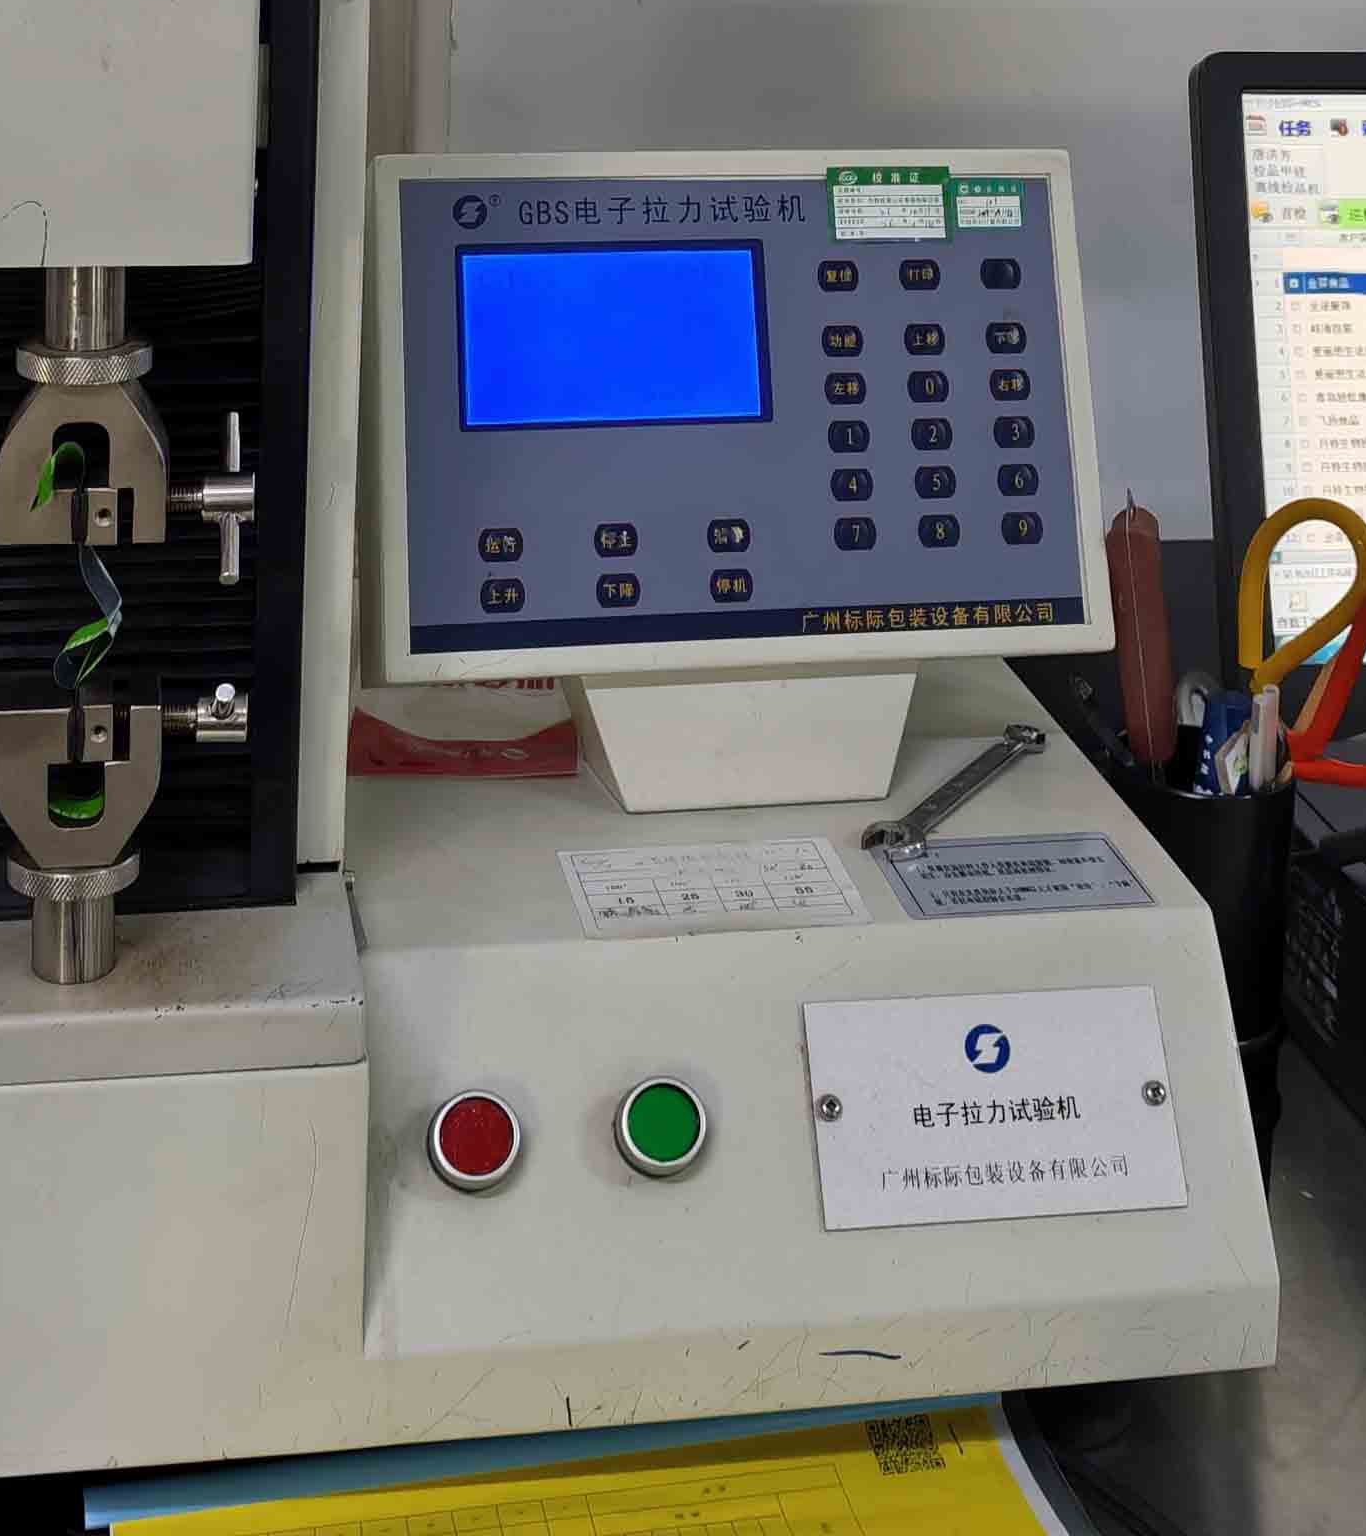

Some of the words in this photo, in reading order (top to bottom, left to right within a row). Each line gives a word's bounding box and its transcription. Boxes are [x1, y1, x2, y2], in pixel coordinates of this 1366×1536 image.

[1279, 120, 1312, 137] 任务
[518, 193, 806, 227] GBS电子拉力试验机
[925, 377, 934, 395] 0
[847, 427, 853, 445] 1
[929, 425, 938, 443] 2
[1011, 423, 1020, 441] 3
[848, 475, 858, 494] 4
[932, 473, 941, 491] 5
[1015, 471, 1024, 489] 6
[851, 524, 860, 543] 7
[936, 521, 945, 539] 8
[1018, 519, 1028, 536] 9
[803, 603, 1055, 633] 广州标际包装设备有限公司
[912, 1095, 1082, 1128] 电子拉力试验机
[880, 1154, 1130, 1192] 广州标际包装设备有限公司
